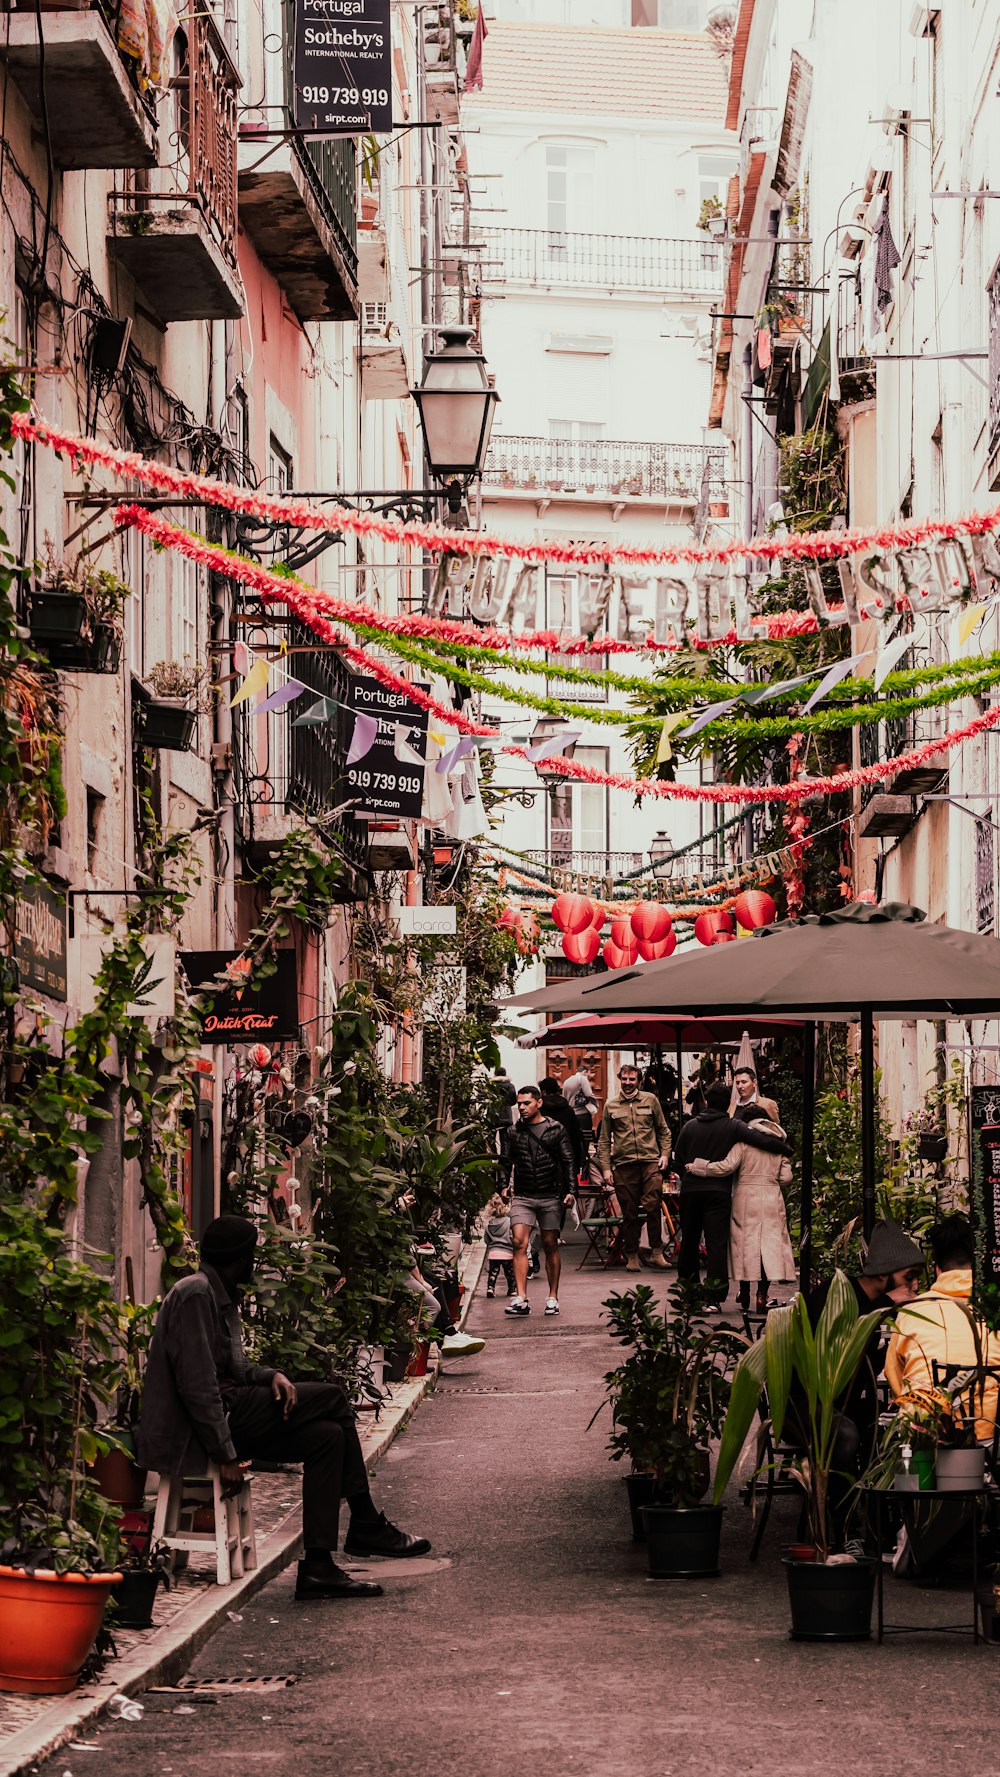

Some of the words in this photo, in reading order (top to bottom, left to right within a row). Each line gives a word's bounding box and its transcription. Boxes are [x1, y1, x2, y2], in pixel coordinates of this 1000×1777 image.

[303, 0, 365, 16] Portugal
[304, 27, 384, 50] Sotheby's
[304, 49, 359, 59] INTERNATIONAL
[359, 51, 384, 60] REALTY
[302, 86, 329, 104] 919
[331, 87, 360, 105] 739
[361, 88, 389, 107] 919
[325, 113, 367, 125] sirpt.com
[428, 550, 541, 632] RUA
[577, 572, 769, 646] VERDE
[348, 769, 371, 788] 919
[373, 772, 397, 791] 739
[398, 776, 421, 794] 919
[550, 867, 614, 901] GREEN
[631, 873, 706, 902] STREET
[721, 848, 798, 891] LISBON
[412, 909, 452, 932] barro
[204, 1015, 242, 1032] Dutch
[241, 1014, 279, 1031] Treat
